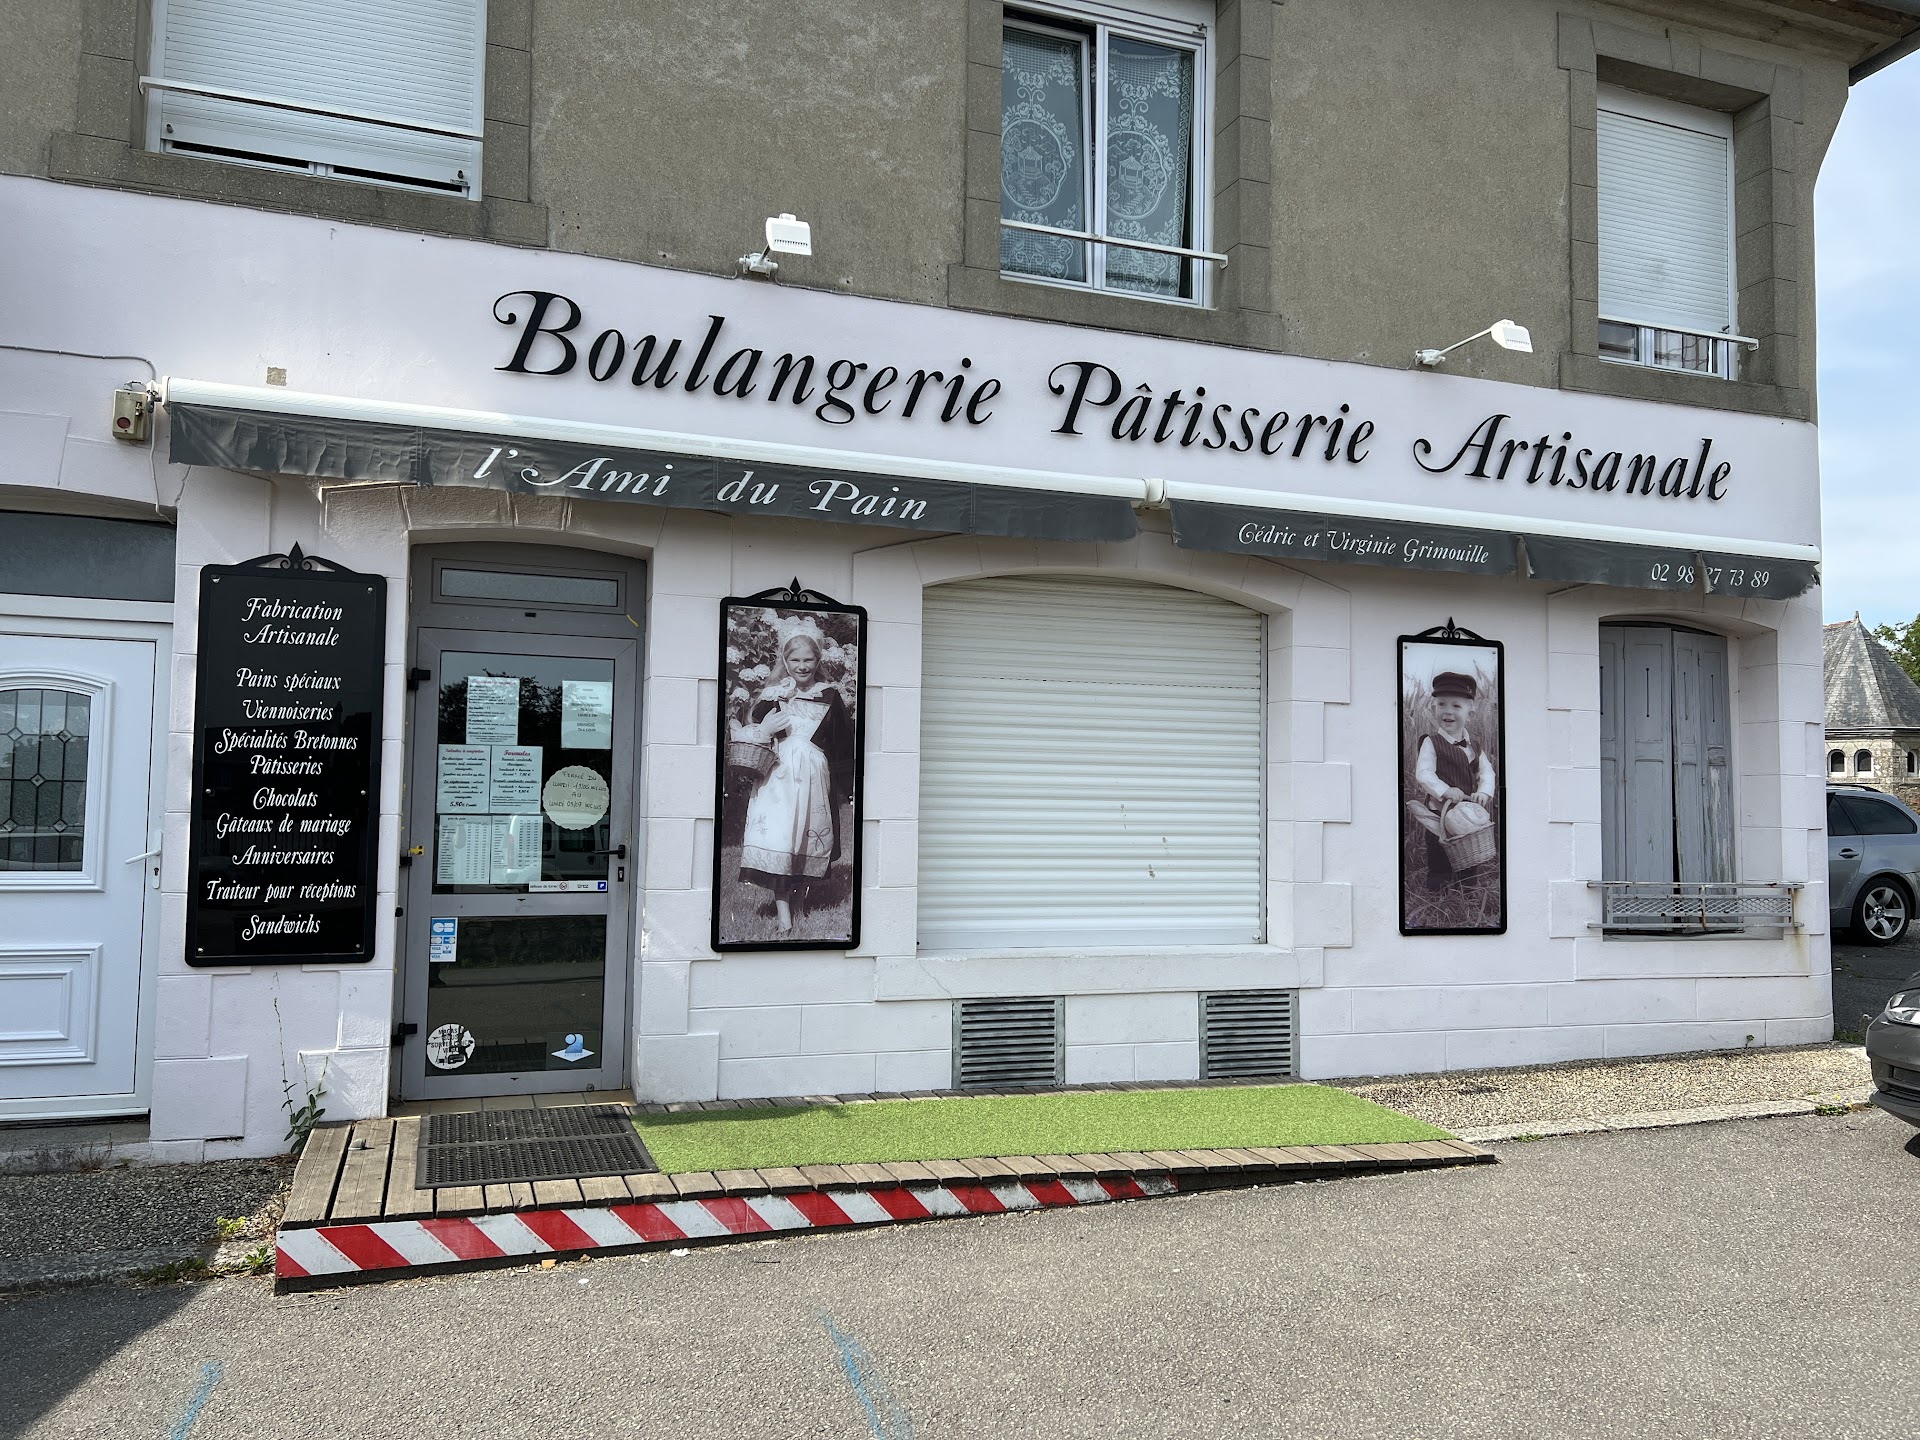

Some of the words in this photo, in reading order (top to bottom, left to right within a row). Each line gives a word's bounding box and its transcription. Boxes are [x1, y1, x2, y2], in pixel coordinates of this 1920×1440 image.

[493, 290, 1002, 425] Boulangerie
[1048, 361, 1375, 464] Pâtisserie
[1413, 414, 1732, 500] Artisanale
[716, 471, 776, 505] du
[809, 478, 927, 521] Pain
[1238, 522, 1297, 546] Cédric
[1304, 532, 1320, 547] et
[1327, 530, 1396, 555] Virginie
[1404, 538, 1489, 564] Grimouille
[1651, 563, 1670, 582] 02
[1676, 565, 1695, 584] 98
[1729, 569, 1745, 587] 73
[1751, 570, 1770, 588] 89
[241, 597, 343, 622] Fabrication
[243, 623, 340, 646] Artisanale
[236, 667, 278, 688] Pains
[283, 670, 342, 692] spéciaux
[242, 699, 334, 720] Viennoiseries
[214, 728, 288, 754] Spécialités
[294, 730, 358, 750] Bretonnes
[250, 754, 323, 775] Pâtisseries
[253, 787, 318, 810] Chocolats
[216, 813, 273, 839] Gâteaux
[279, 813, 294, 832] de
[300, 813, 351, 836] mariage
[232, 845, 334, 865] Anniversaires
[207, 878, 260, 900] Traiteur
[264, 883, 294, 902] pour
[300, 879, 357, 902] réceptions
[242, 914, 320, 941] Sandwichs
